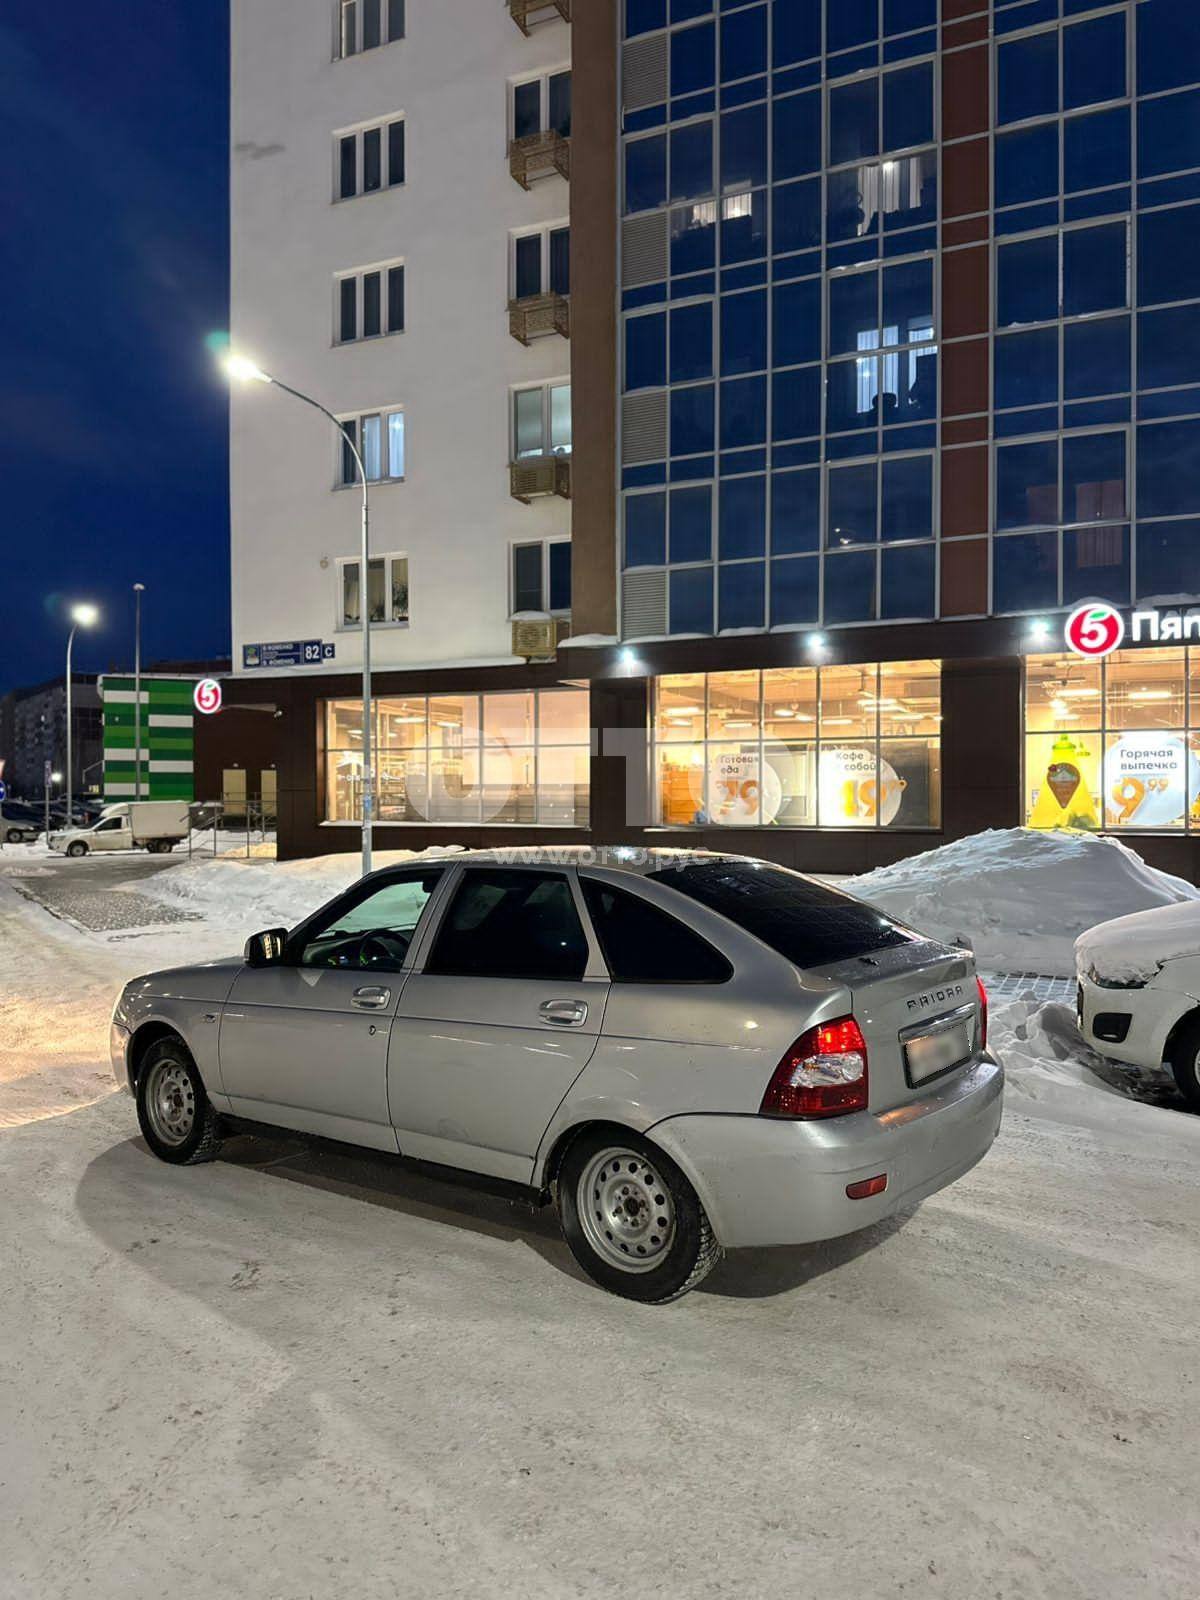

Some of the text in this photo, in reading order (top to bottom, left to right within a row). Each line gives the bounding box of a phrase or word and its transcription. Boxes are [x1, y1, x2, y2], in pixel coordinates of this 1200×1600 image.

[305, 645, 320, 660] 82
[837, 752, 865, 762] Кофе
[1120, 749, 1173, 760] Горячая
[720, 765, 740, 774] еда
[844, 761, 877, 771] собой
[1120, 761, 1178, 770] выпечка
[1112, 777, 1146, 819] 9
[907, 985, 965, 1010] PRIORA
